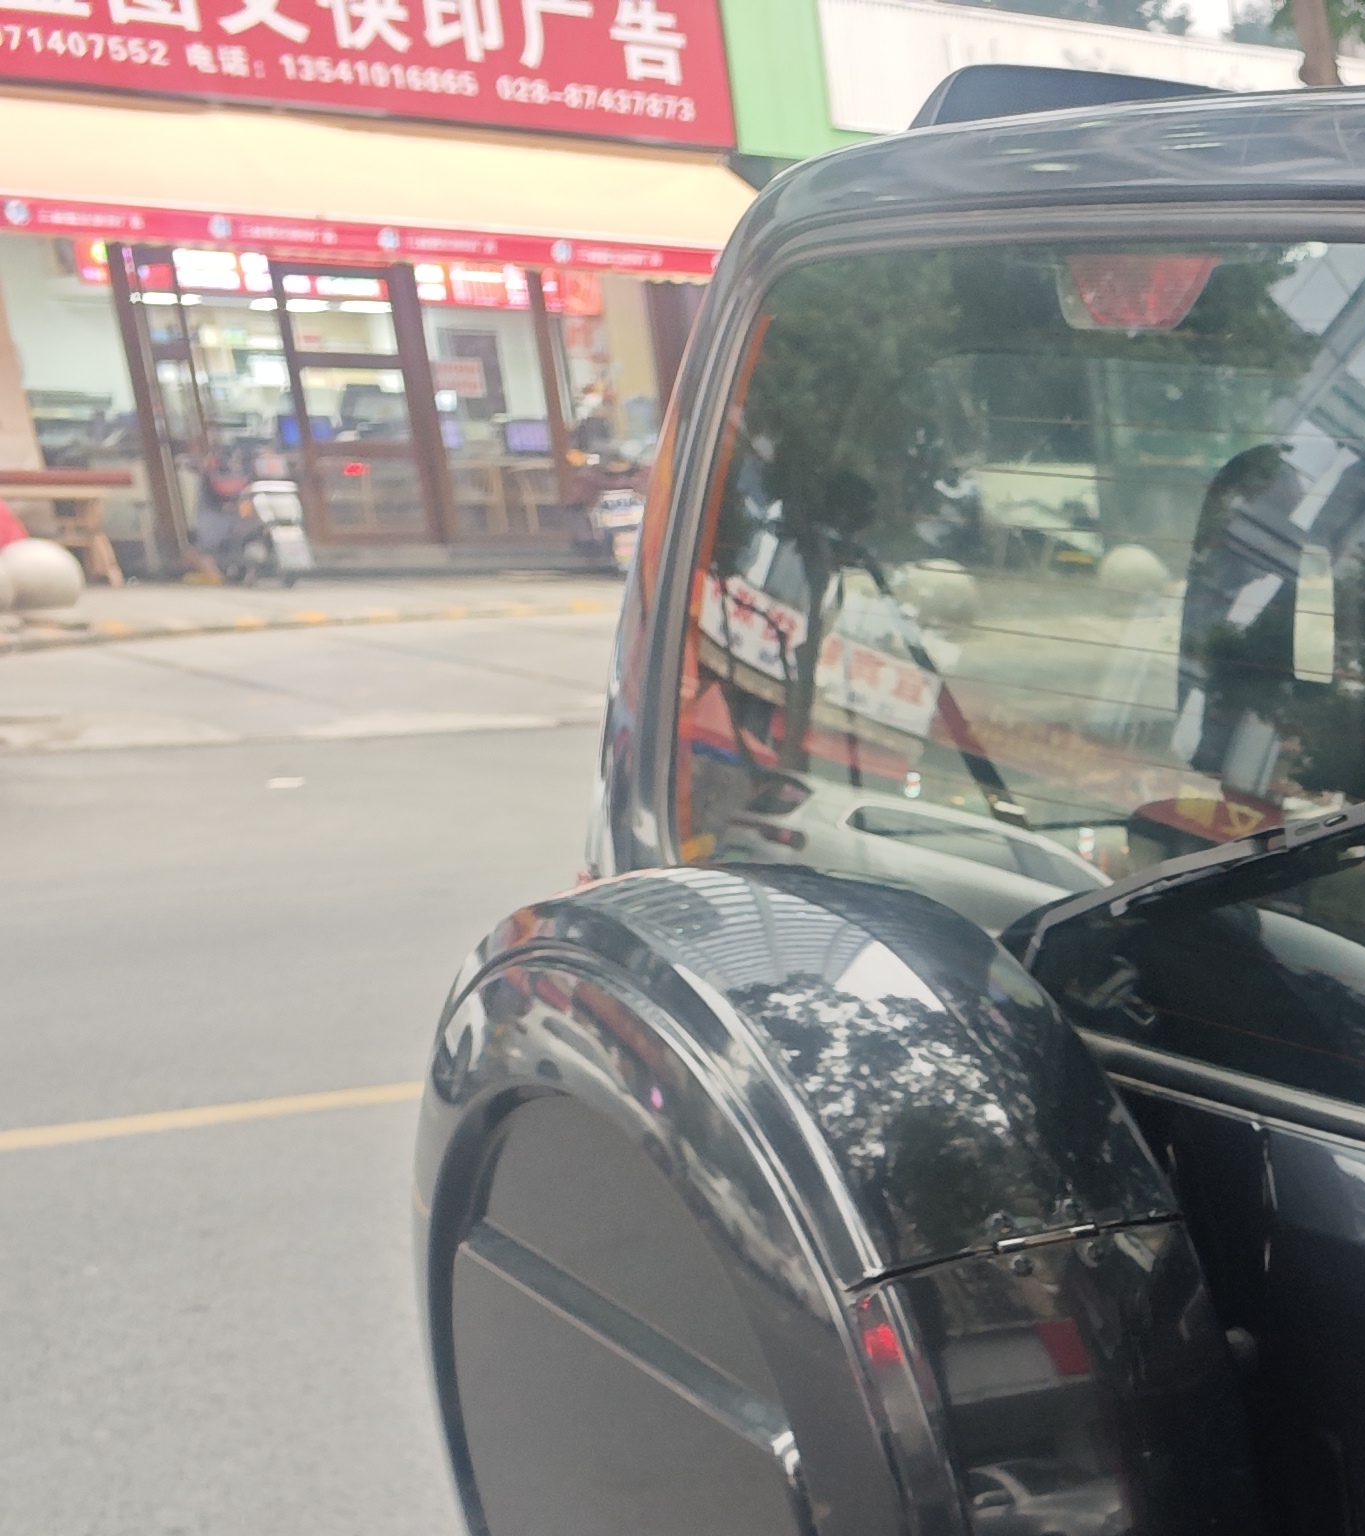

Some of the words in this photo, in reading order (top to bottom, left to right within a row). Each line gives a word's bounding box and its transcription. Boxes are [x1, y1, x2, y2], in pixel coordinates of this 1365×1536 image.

[0, 0, 688, 86] 快印广告
[0, 24, 171, 67] 71407552
